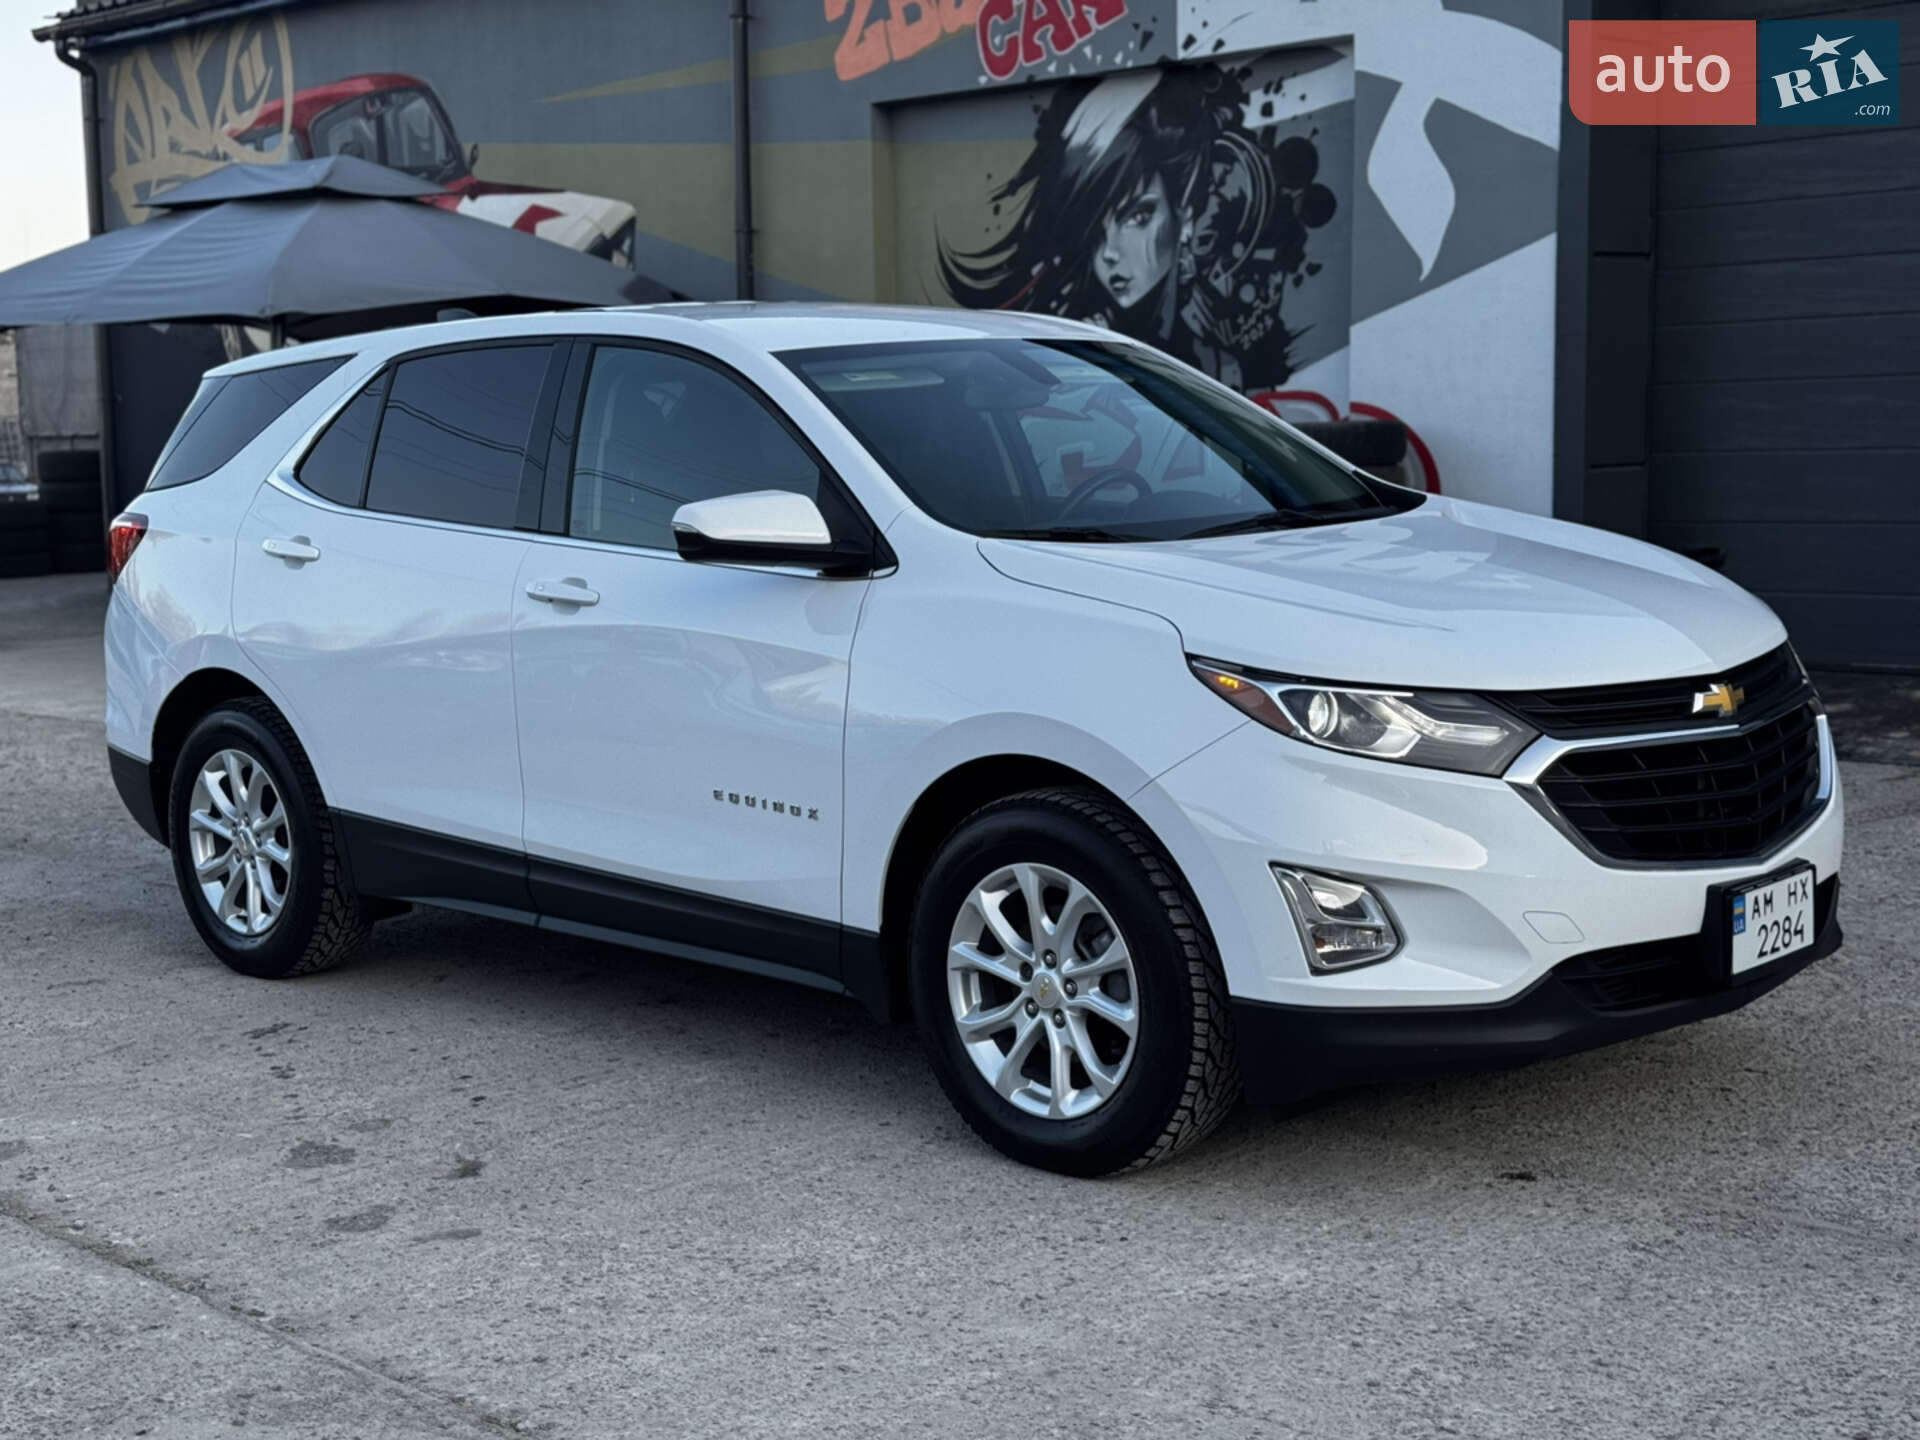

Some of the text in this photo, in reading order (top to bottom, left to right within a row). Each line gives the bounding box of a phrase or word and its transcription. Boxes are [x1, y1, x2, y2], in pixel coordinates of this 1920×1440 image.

[713, 789, 819, 821] EQUINOX
[1751, 876, 1809, 920] AM HX
[1757, 910, 1805, 959] 2284
